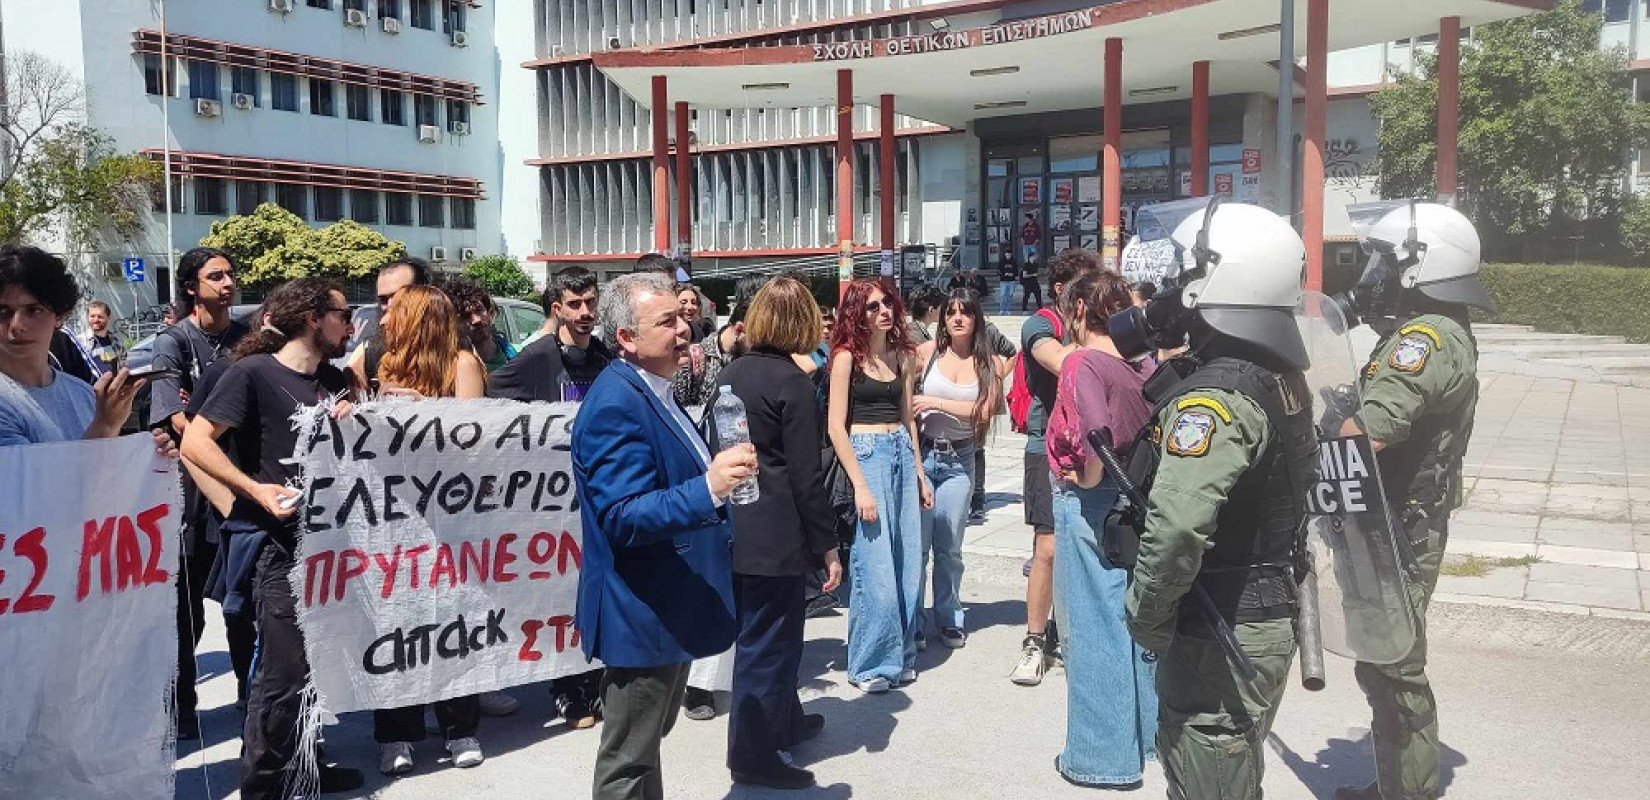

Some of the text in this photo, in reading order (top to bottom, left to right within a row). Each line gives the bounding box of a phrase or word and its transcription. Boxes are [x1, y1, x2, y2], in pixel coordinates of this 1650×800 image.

[813, 8, 1092, 60] ΣΧΟΛΗ ΘΕΤΙΚΩΝ ΕΠΙΣΤΗΜΩΝ
[308, 413, 483, 461] ΑΣΥΛΟ
[304, 470, 580, 533] ΕΛΕΥΘΕΡΙΩ
[76, 503, 169, 602] ΜΑΣ
[304, 530, 582, 608] ΠΡΥΤΑΝΕΩΝ
